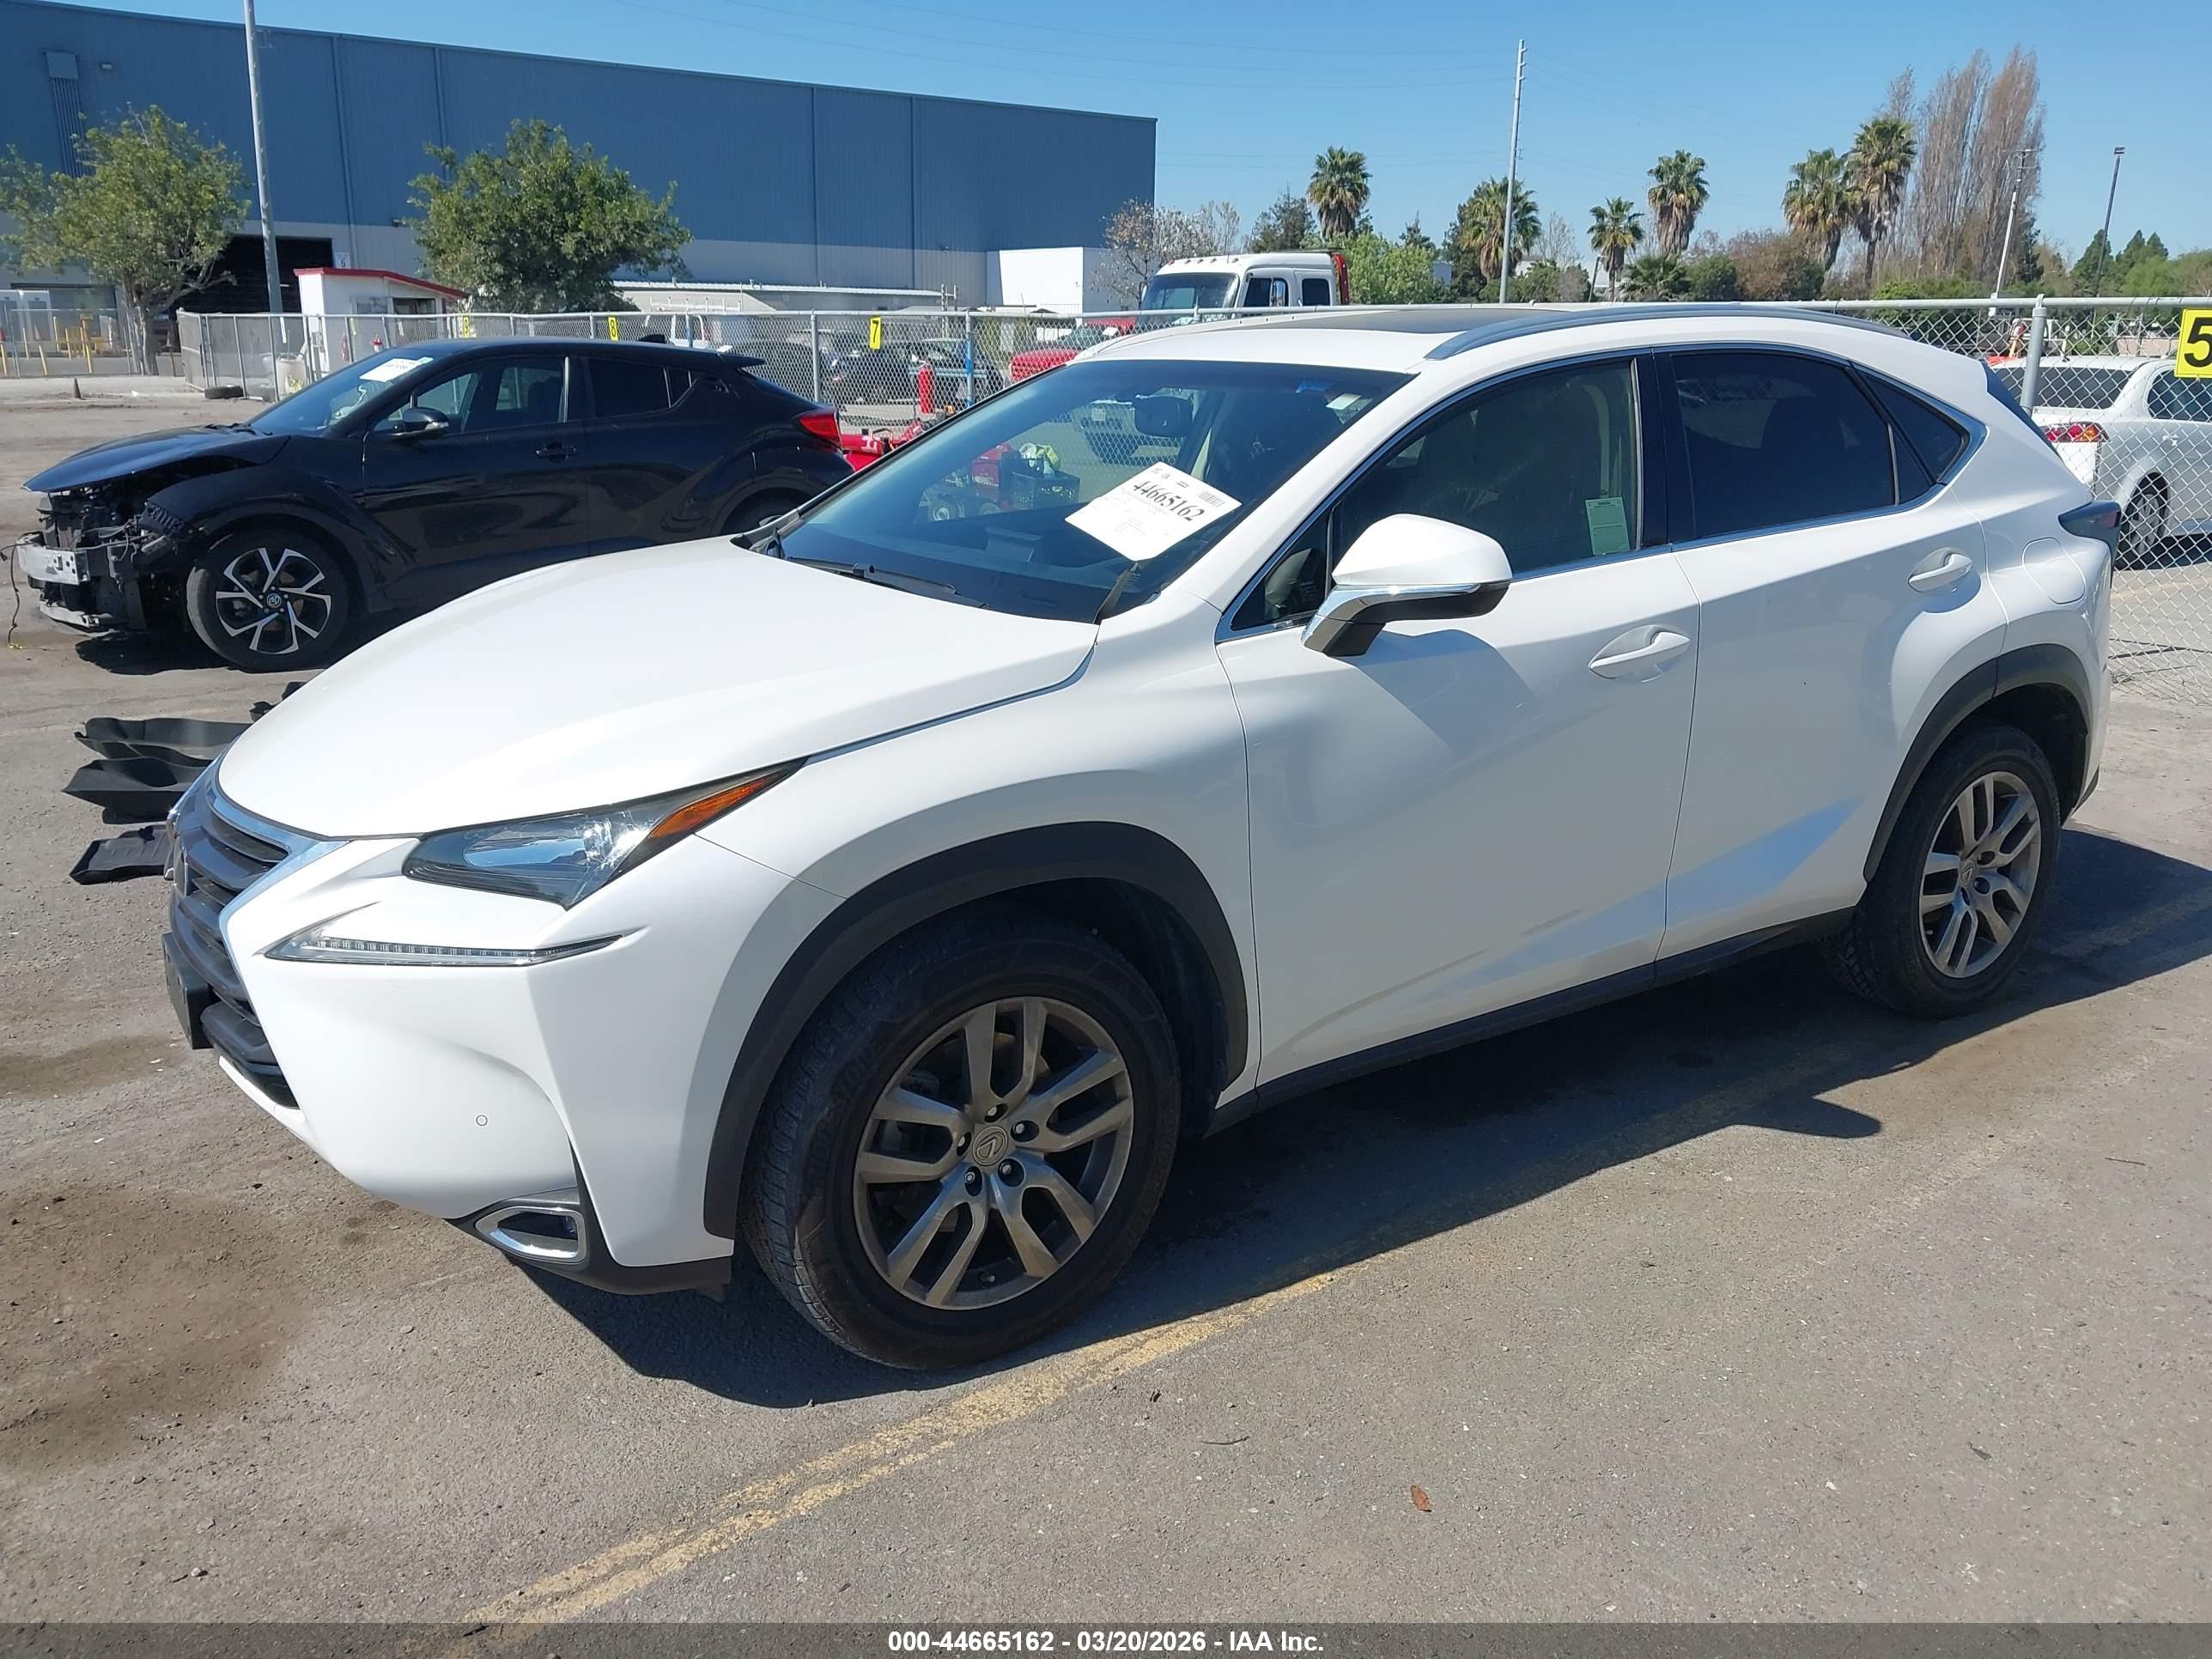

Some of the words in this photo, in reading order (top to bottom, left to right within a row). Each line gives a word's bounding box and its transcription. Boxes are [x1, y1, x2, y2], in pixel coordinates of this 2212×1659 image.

[610, 319, 617, 337] 8
[872, 319, 879, 344] 7
[2184, 317, 2212, 368] 5
[1133, 480, 1206, 521] 44665162
